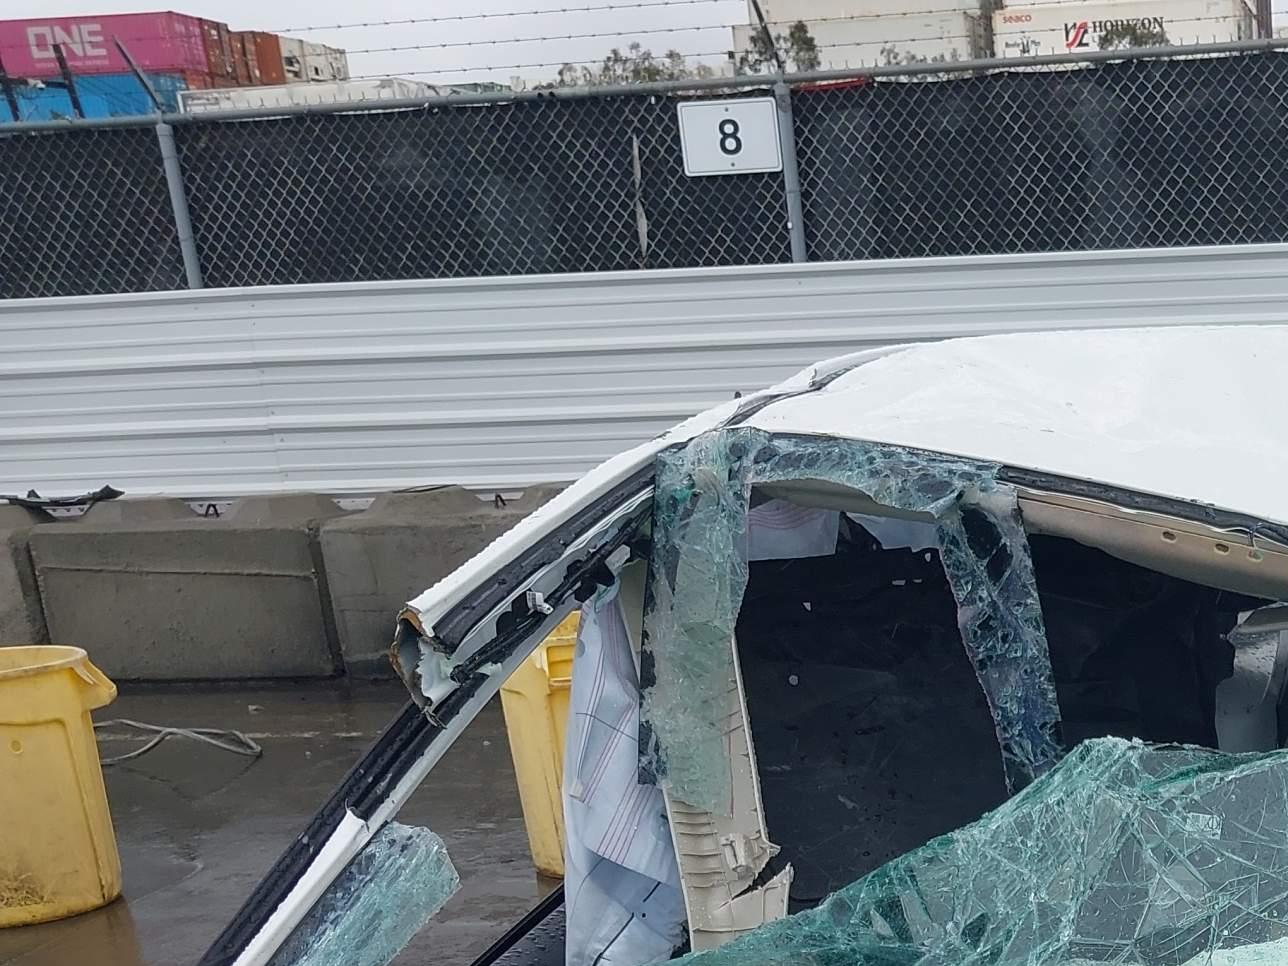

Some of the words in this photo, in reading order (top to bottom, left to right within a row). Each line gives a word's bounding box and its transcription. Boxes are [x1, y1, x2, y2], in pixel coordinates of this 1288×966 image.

[1002, 14, 1032, 24] seaco
[26, 24, 107, 59] ONE
[718, 118, 742, 155] 8
